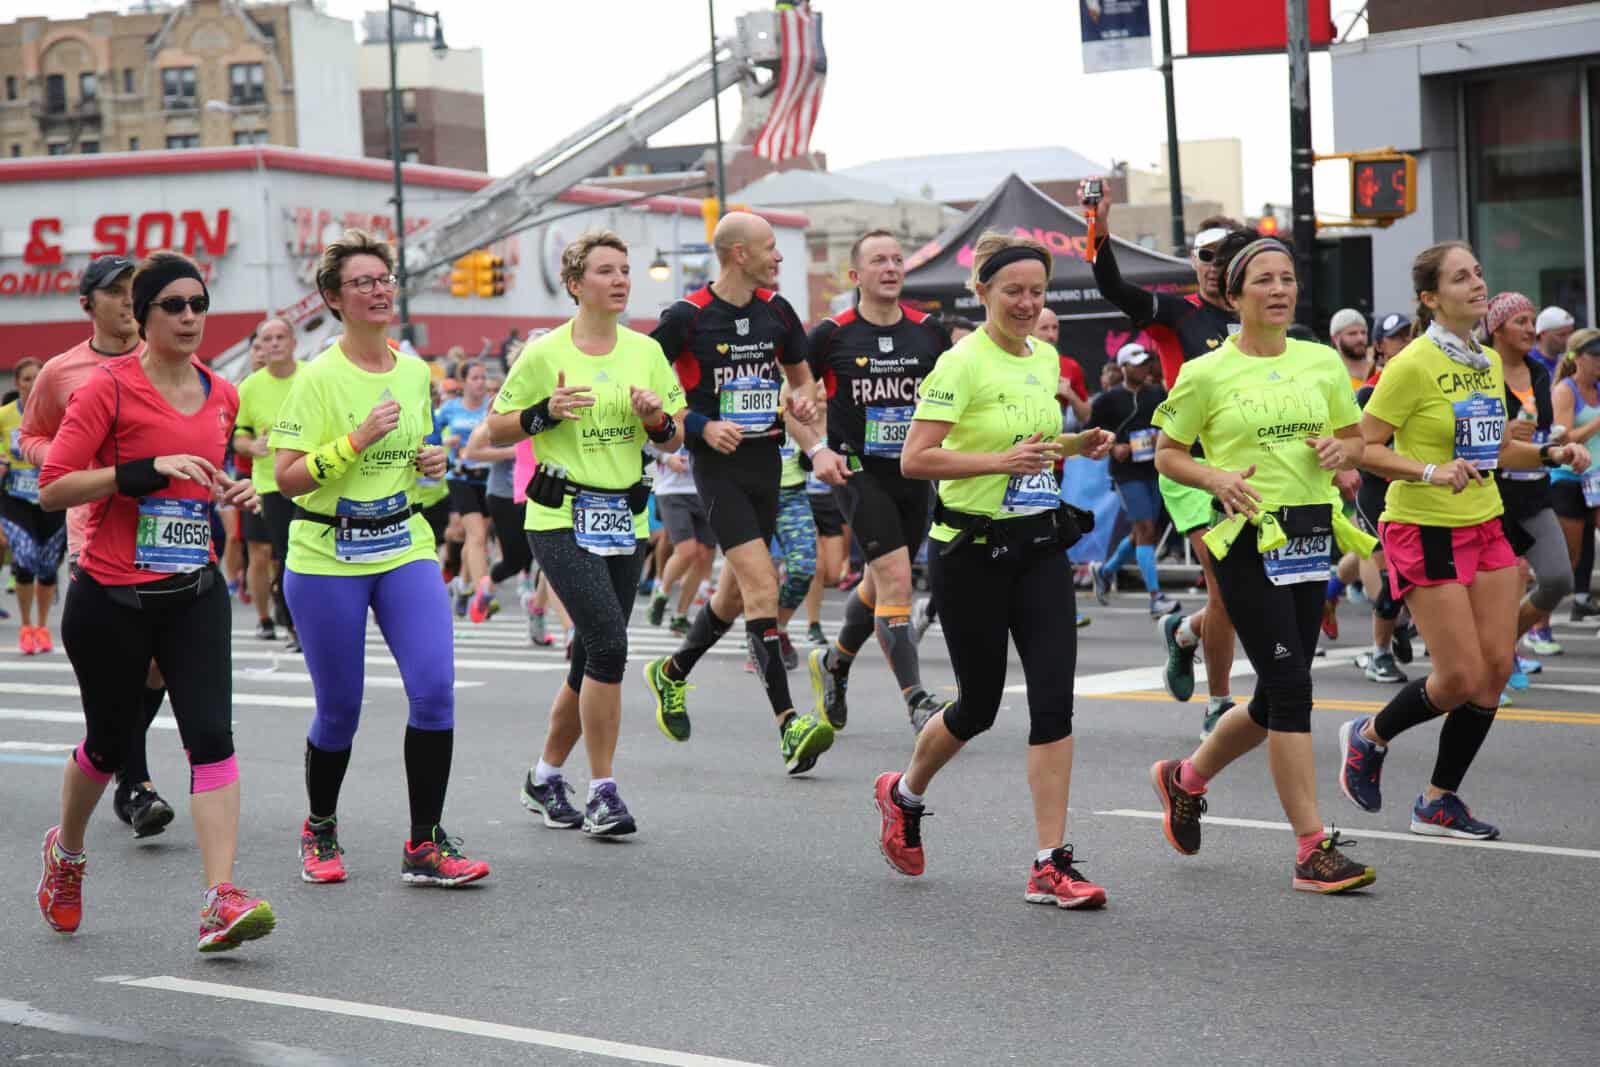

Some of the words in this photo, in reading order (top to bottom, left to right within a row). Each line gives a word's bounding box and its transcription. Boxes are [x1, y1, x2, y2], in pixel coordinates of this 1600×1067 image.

[23, 217, 63, 265] &
[90, 209, 229, 259] SON
[0, 271, 82, 295] ONIC
[870, 358, 898, 366] Thomas
[714, 361, 776, 395] FRANC
[1438, 370, 1496, 393] CARRIE
[742, 393, 772, 410] 51813
[582, 426, 636, 438] LAURENCE
[883, 424, 912, 441] 339
[1257, 422, 1323, 438] CATHERINE
